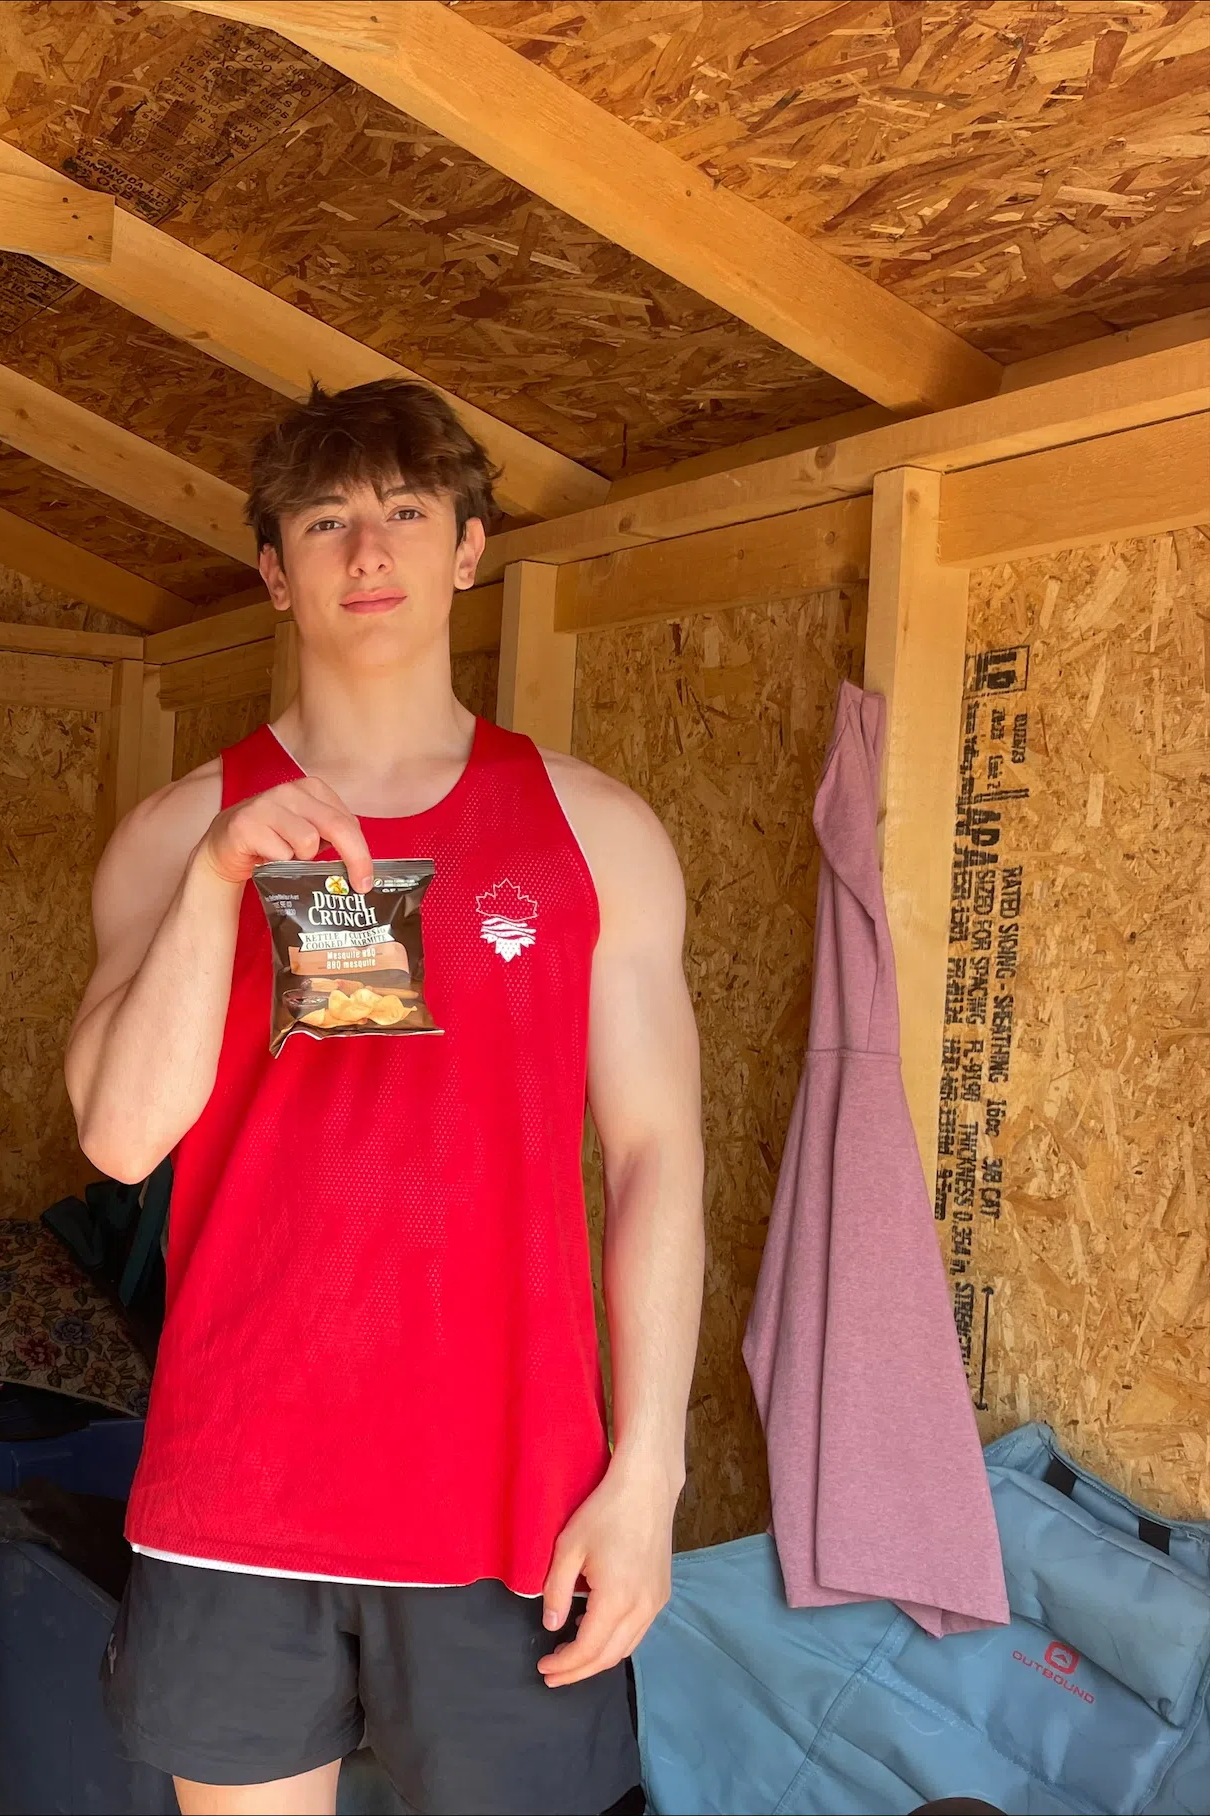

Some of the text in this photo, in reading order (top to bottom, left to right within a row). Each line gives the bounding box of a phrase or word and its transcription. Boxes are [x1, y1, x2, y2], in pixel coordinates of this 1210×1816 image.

[94, 176, 134, 200] OSB
[312, 891, 367, 913] DUTCH
[972, 868, 996, 916] SIZED
[999, 864, 1023, 920] RATED
[308, 907, 378, 928] CRUNCH
[305, 932, 340, 942] KETTLE
[305, 939, 342, 949] COOKED
[348, 929, 376, 939] CUITES
[350, 934, 386, 946] MARMITE
[970, 918, 992, 951] FOR
[326, 949, 376, 961] Mesquite BBQ
[995, 922, 1019, 980] SIDING
[327, 960, 376, 970] BBQ mesquite
[987, 994, 1014, 1084] SHEATHING
[953, 1120, 978, 1207] THICKNESS
[977, 1187, 1002, 1220] CAT
[1012, 1650, 1095, 1704] OUTBOUND
